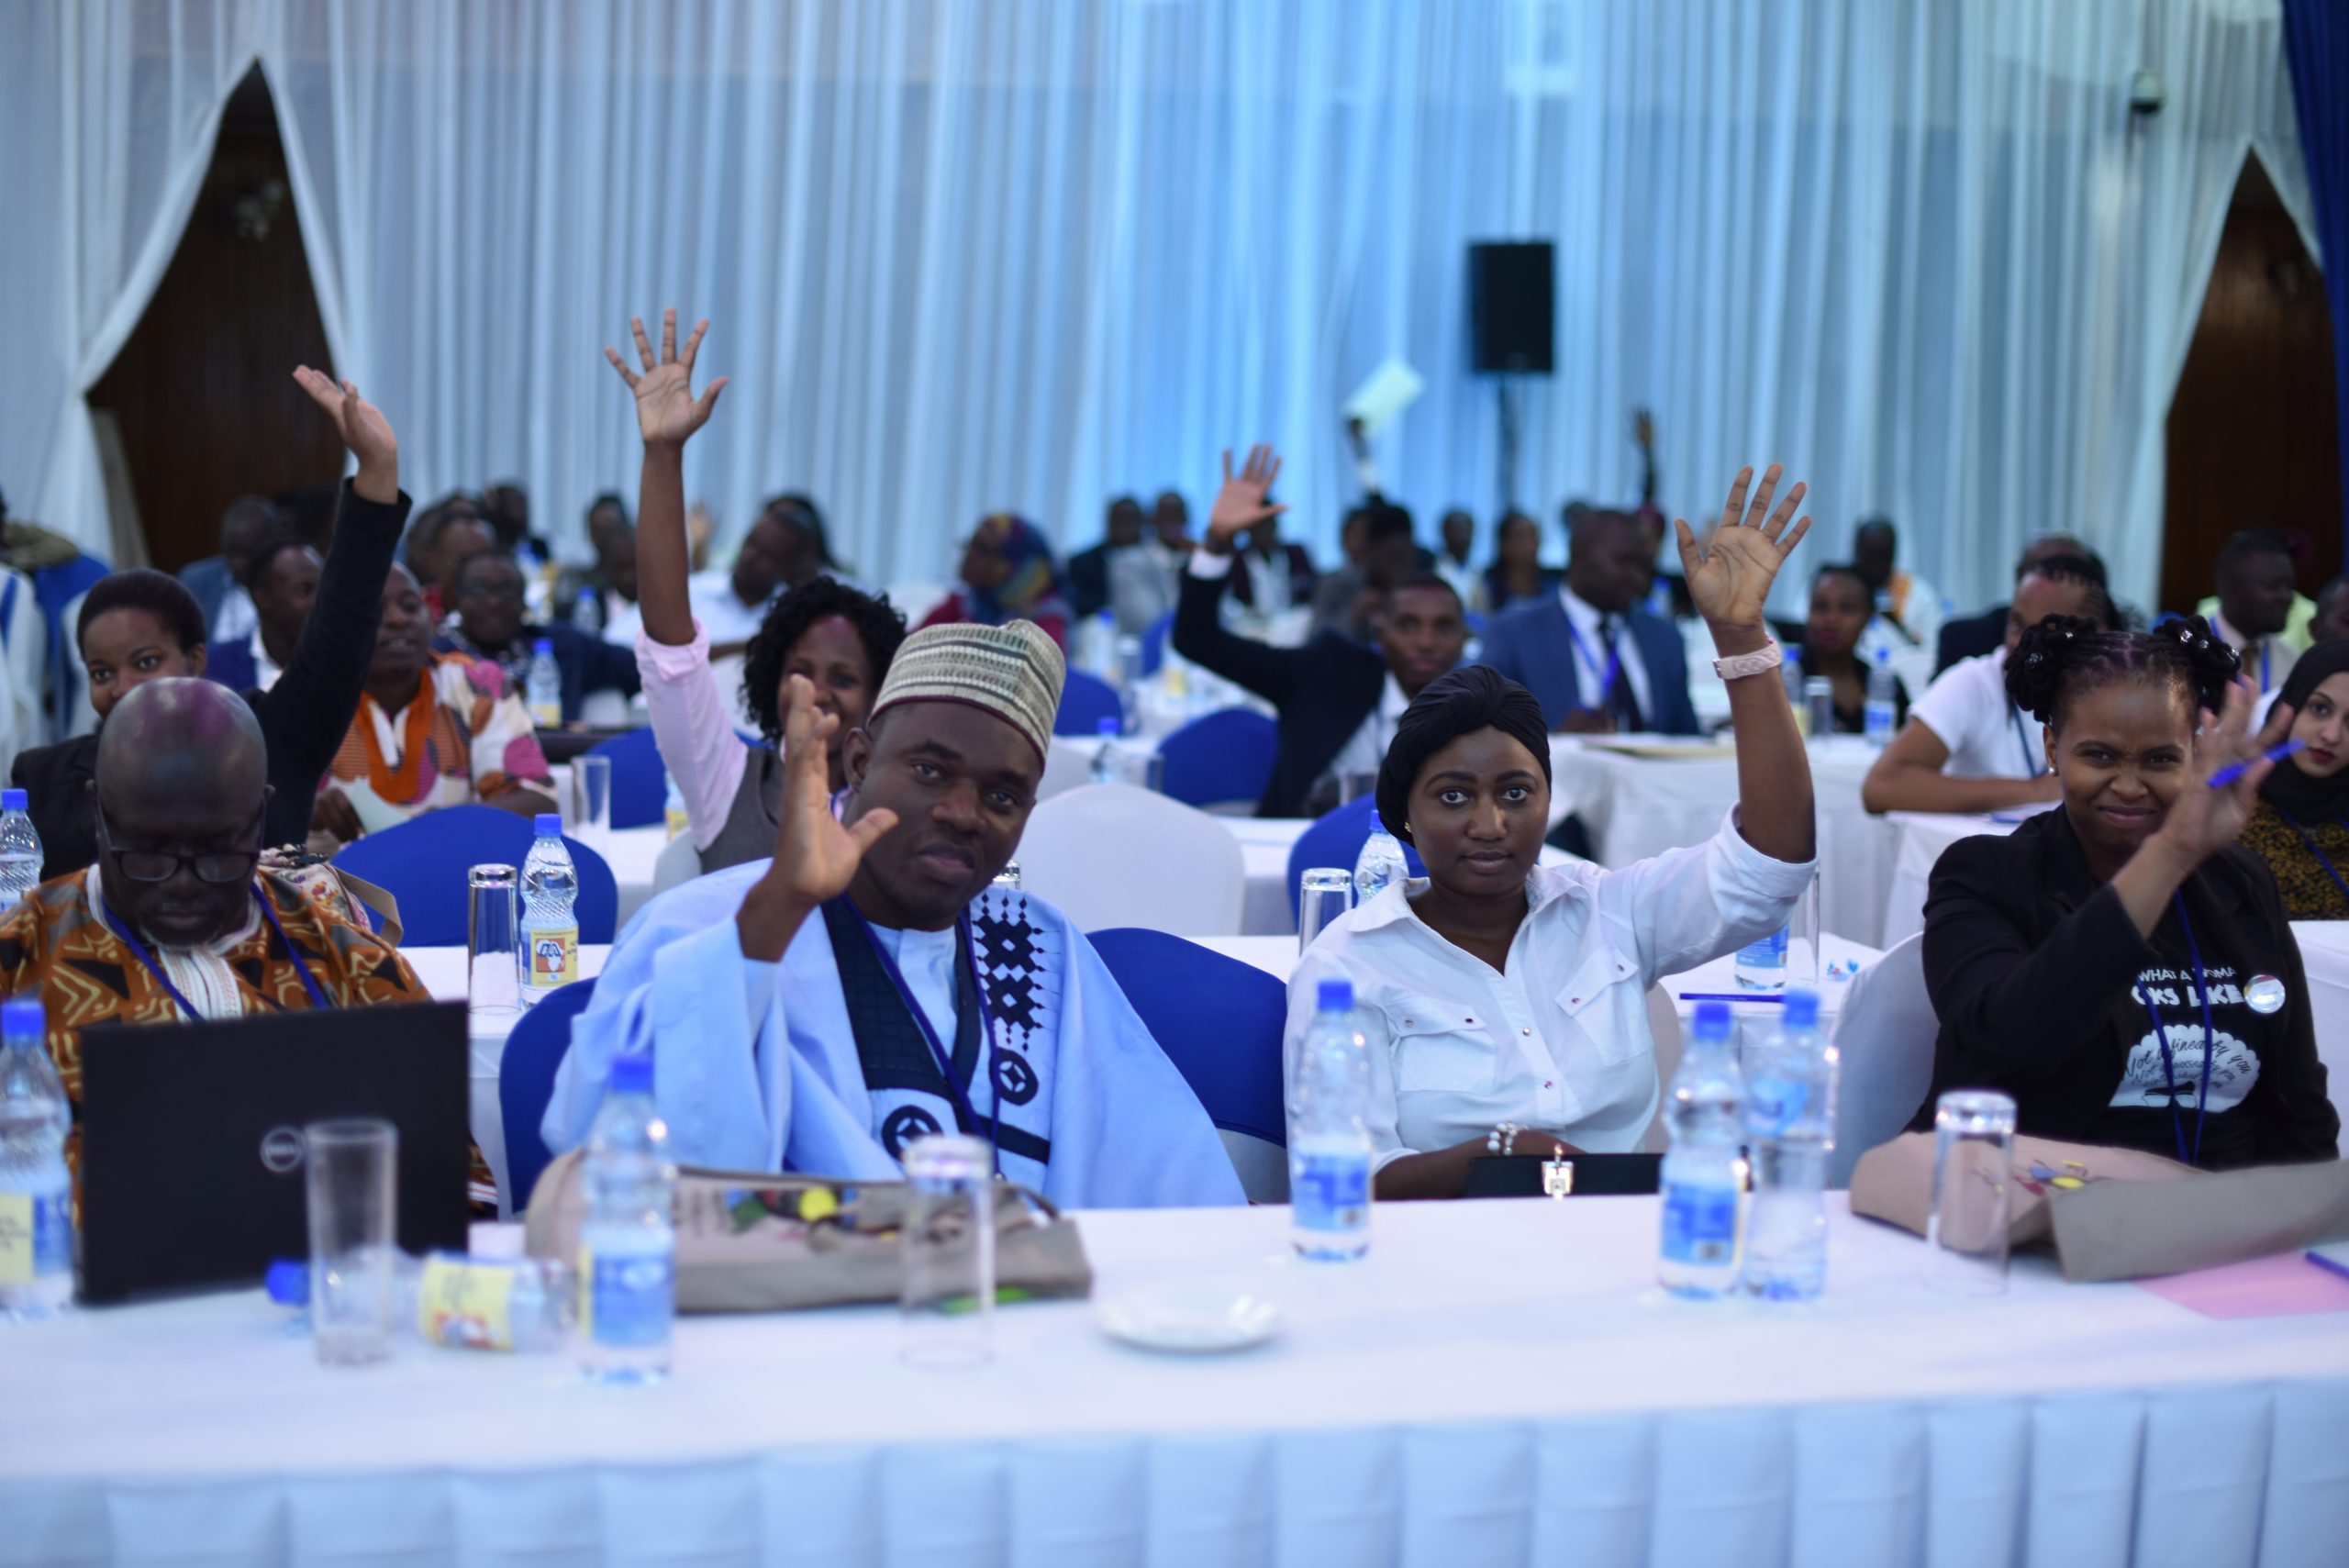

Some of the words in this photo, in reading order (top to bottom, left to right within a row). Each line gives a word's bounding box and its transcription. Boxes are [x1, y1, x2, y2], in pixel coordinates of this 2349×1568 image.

[2137, 968, 2177, 983] WHAT
[2179, 969, 2194, 981] A
[2186, 983, 2245, 1007] LKE
